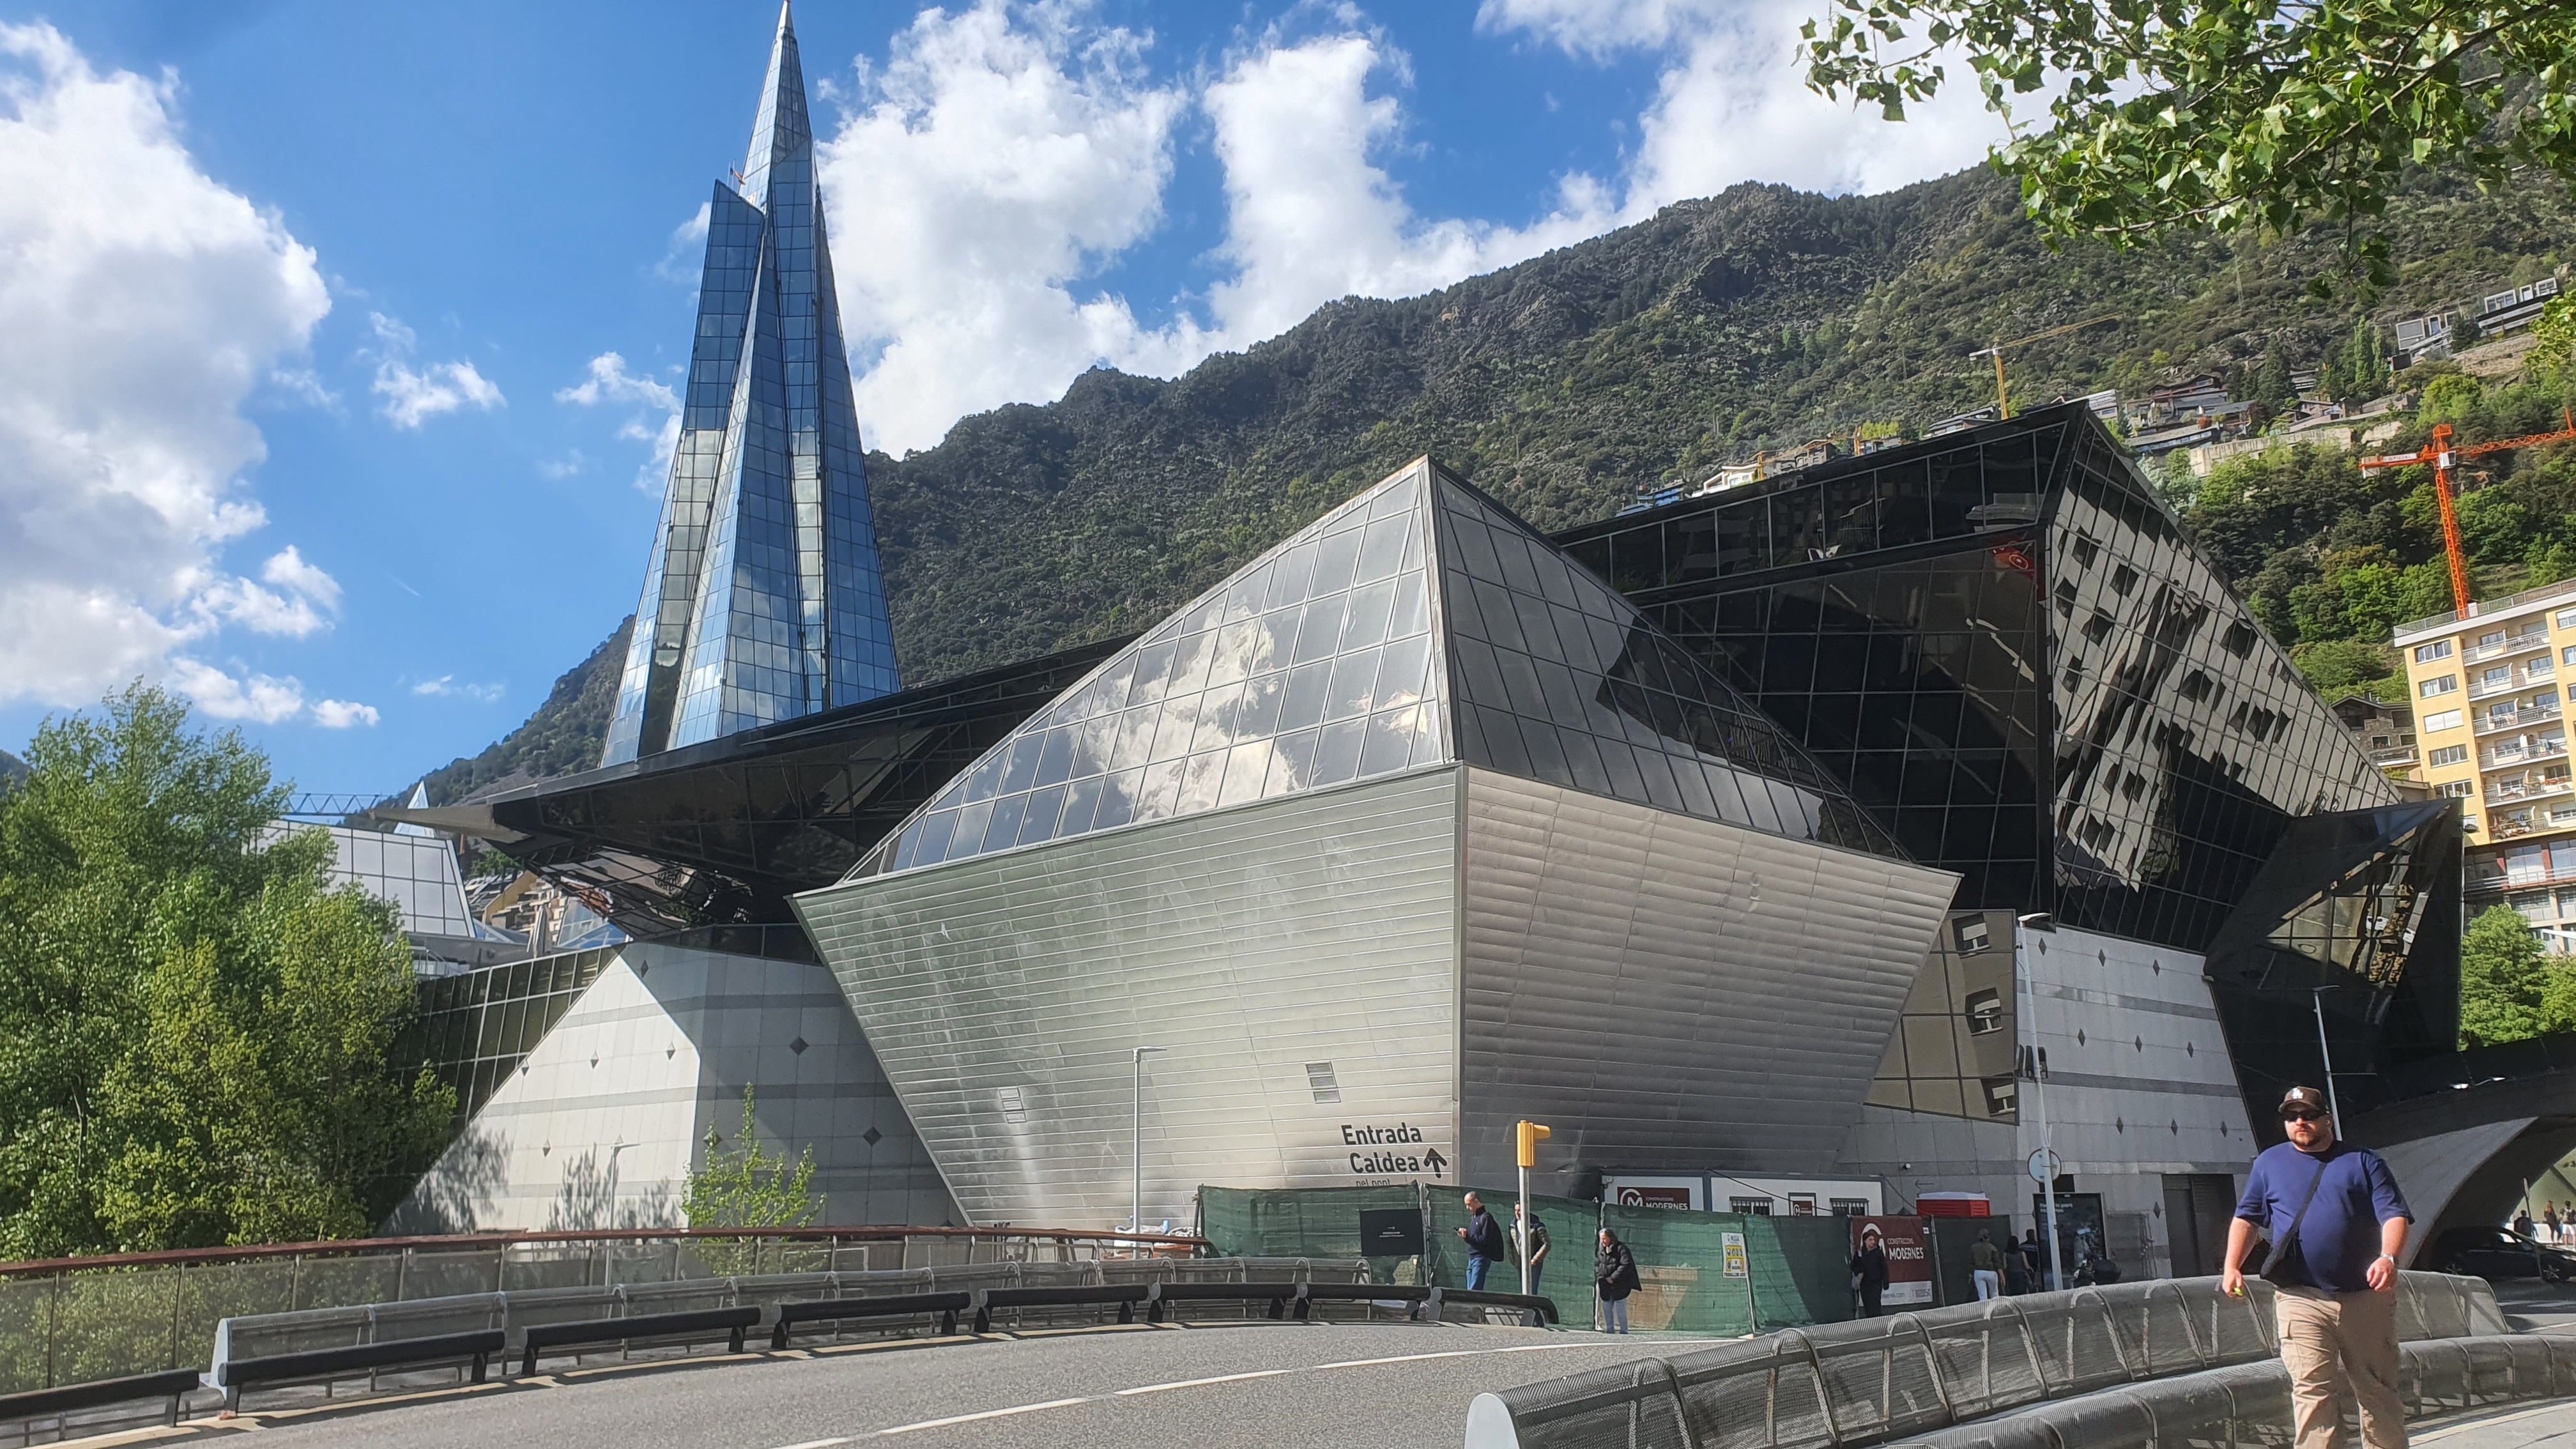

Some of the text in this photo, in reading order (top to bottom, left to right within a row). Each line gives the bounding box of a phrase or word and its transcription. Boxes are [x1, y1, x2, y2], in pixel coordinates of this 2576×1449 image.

[1341, 1122, 1423, 1146] Entrada
[1350, 1151, 1420, 1174] Caldea
[1646, 1202, 1688, 1211] MODERNES
[1889, 1246, 1924, 1261] MODERNES
